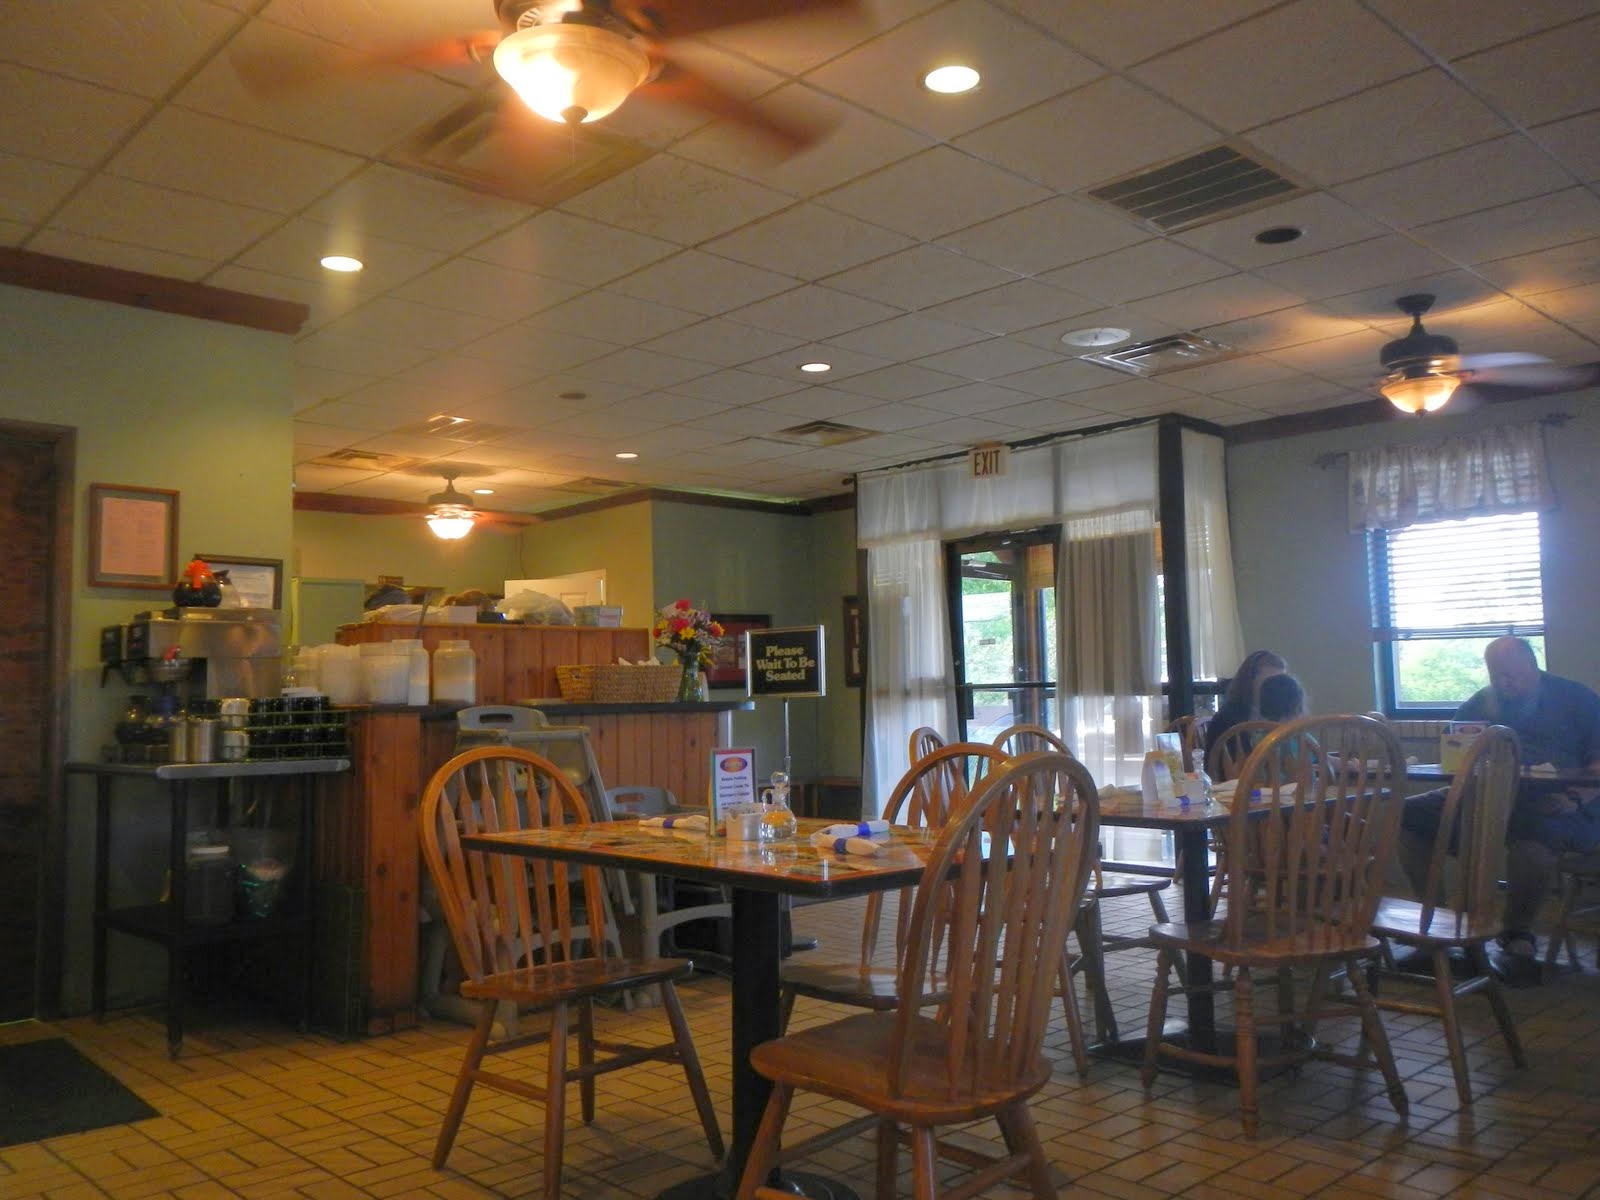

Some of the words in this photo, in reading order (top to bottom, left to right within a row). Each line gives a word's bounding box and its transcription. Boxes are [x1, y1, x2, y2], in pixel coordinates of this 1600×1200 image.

[974, 450, 1000, 475] EXIT
[766, 645, 804, 656] Please
[756, 659, 782, 670] Wait
[783, 657, 797, 669] To
[799, 656, 816, 668] Be
[765, 669, 805, 681] Seated
